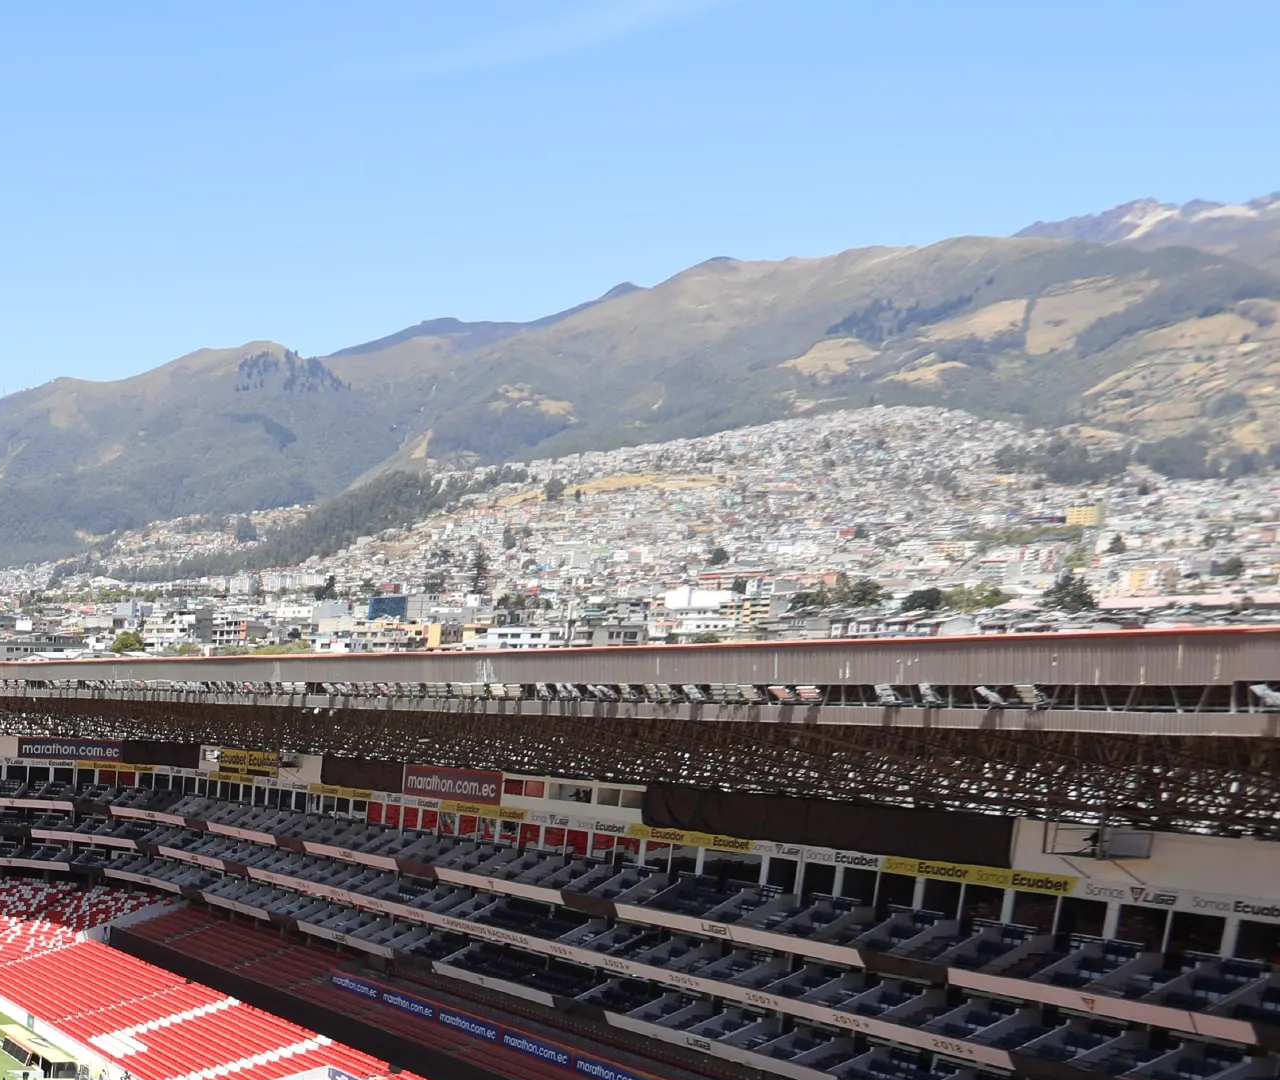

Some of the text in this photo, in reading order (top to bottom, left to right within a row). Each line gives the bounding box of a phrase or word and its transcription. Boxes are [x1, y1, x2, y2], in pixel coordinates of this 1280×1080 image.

[22, 743, 120, 758] marathon.com.ec
[407, 774, 497, 798] marathon.com.ec
[594, 821, 625, 833] Ecuabet
[650, 829, 750, 850] Ecuador Ecuabet
[834, 852, 879, 868] Ecuabet
[917, 862, 969, 879] Ecuador
[1011, 873, 1069, 892] Ecuabet
[1086, 883, 1180, 906] Somos LIGA
[1190, 895, 1231, 910] Somos
[701, 922, 727, 937] LIGA
[332, 975, 378, 998] marathon.com.ec
[382, 991, 433, 1018] marathon.com.ec
[745, 991, 772, 1005] 2007
[439, 1011, 497, 1041] marathon.com.ec
[831, 1012, 862, 1029] 2010
[503, 1033, 568, 1065] marathon.com.ec
[930, 1037, 966, 1054] 2018
